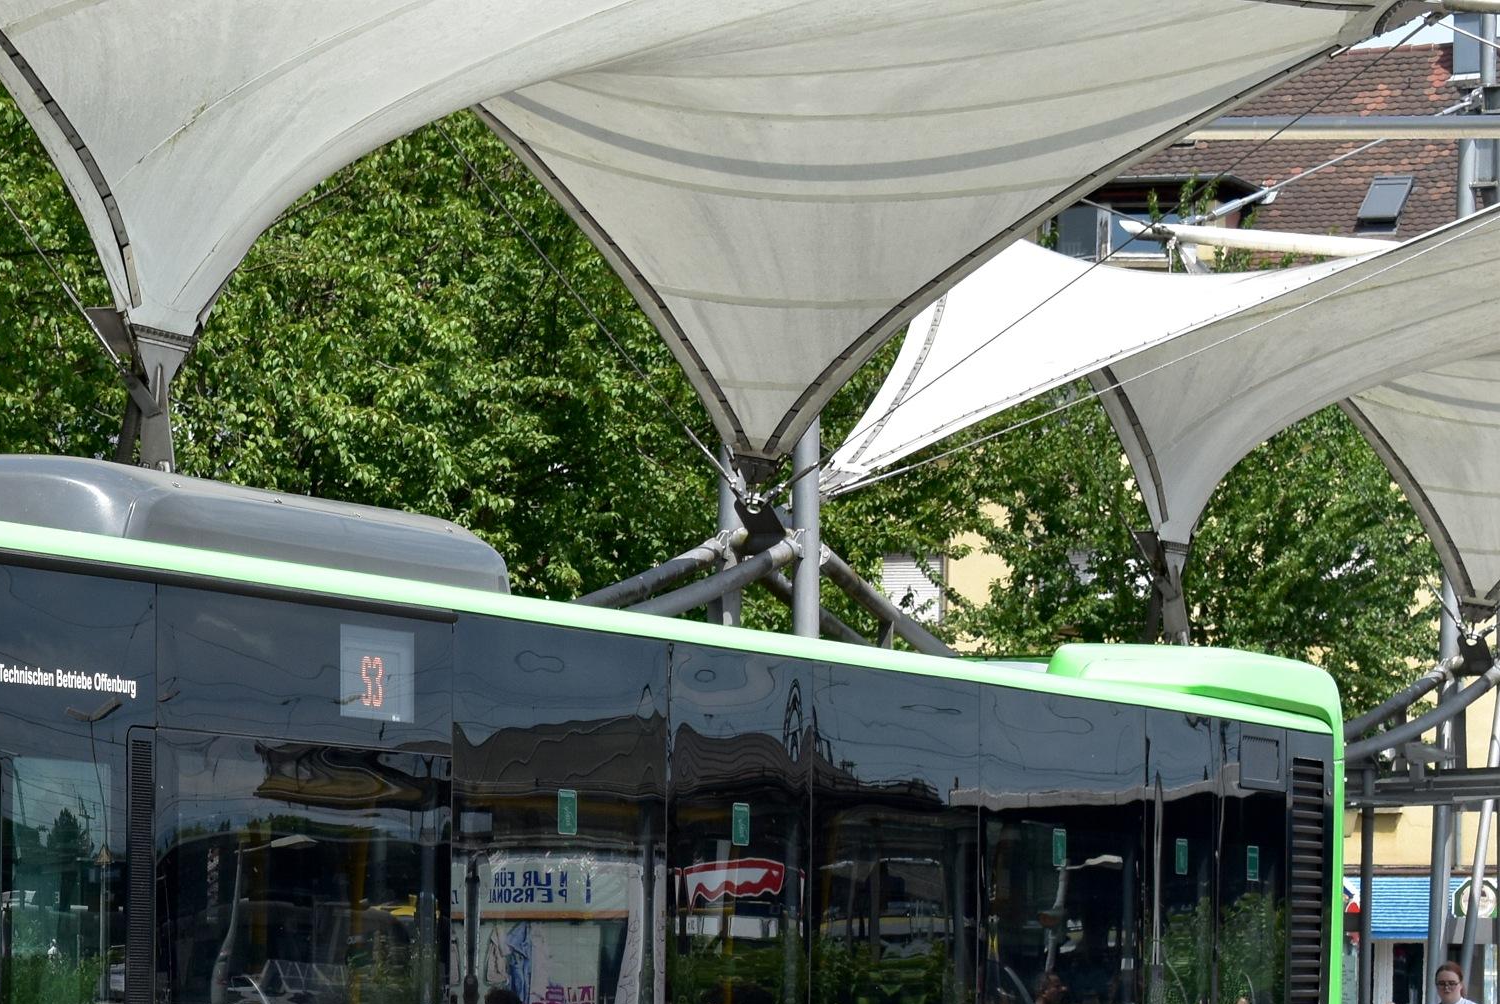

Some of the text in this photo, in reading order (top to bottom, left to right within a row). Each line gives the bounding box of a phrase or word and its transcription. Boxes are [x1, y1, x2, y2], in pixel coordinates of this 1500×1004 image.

[56, 669, 92, 691] Betriebe
[94, 673, 137, 698] Offenburg
[360, 656, 385, 708] S3
